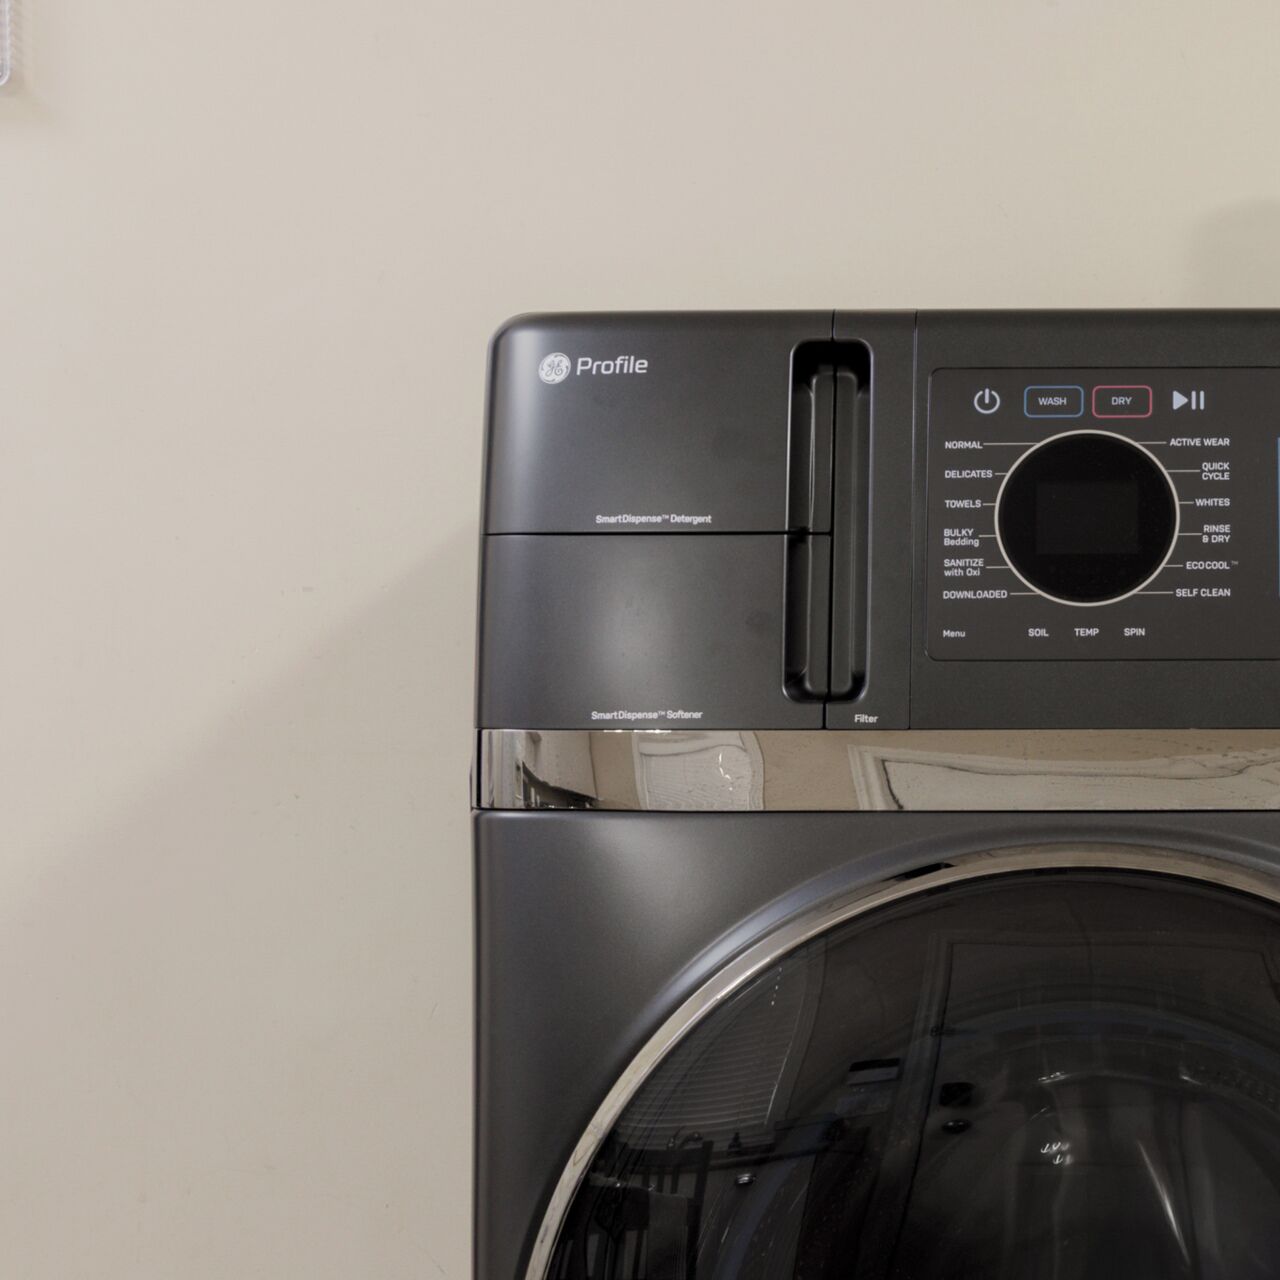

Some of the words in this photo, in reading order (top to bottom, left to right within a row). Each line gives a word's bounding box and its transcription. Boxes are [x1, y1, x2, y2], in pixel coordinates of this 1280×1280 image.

[577, 356, 648, 375] Profile
[1039, 397, 1066, 405] WASH
[1112, 397, 1132, 405] DRY
[944, 441, 983, 449] NORMAL
[1169, 438, 1201, 447] ACTIVE
[1203, 438, 1230, 446] WEAR
[1202, 462, 1230, 470] QUICK
[944, 470, 993, 478] DELICATES
[1202, 472, 1230, 481] CYCLE
[944, 499, 982, 508] TOWELS
[1195, 498, 1230, 507] WHITES
[670, 514, 711, 525] Detergent
[944, 528, 974, 537] BULKY
[1203, 525, 1231, 533] RINSE
[944, 537, 979, 547] Bedding
[1202, 534, 1209, 543] &
[1211, 534, 1231, 543] DRY
[944, 559, 984, 567] SANITIZE
[944, 568, 964, 576] with
[966, 568, 980, 576] Oxi
[943, 590, 1008, 599] DOWNLOADED
[1176, 588, 1198, 597] SELF
[1200, 588, 1231, 597] CLEAN
[943, 629, 966, 637] Menu
[1028, 628, 1049, 636] SOIL
[1074, 628, 1100, 636] TEMP
[1123, 628, 1145, 636] SPIN
[666, 710, 703, 719] Softener
[854, 714, 879, 724] Filter
